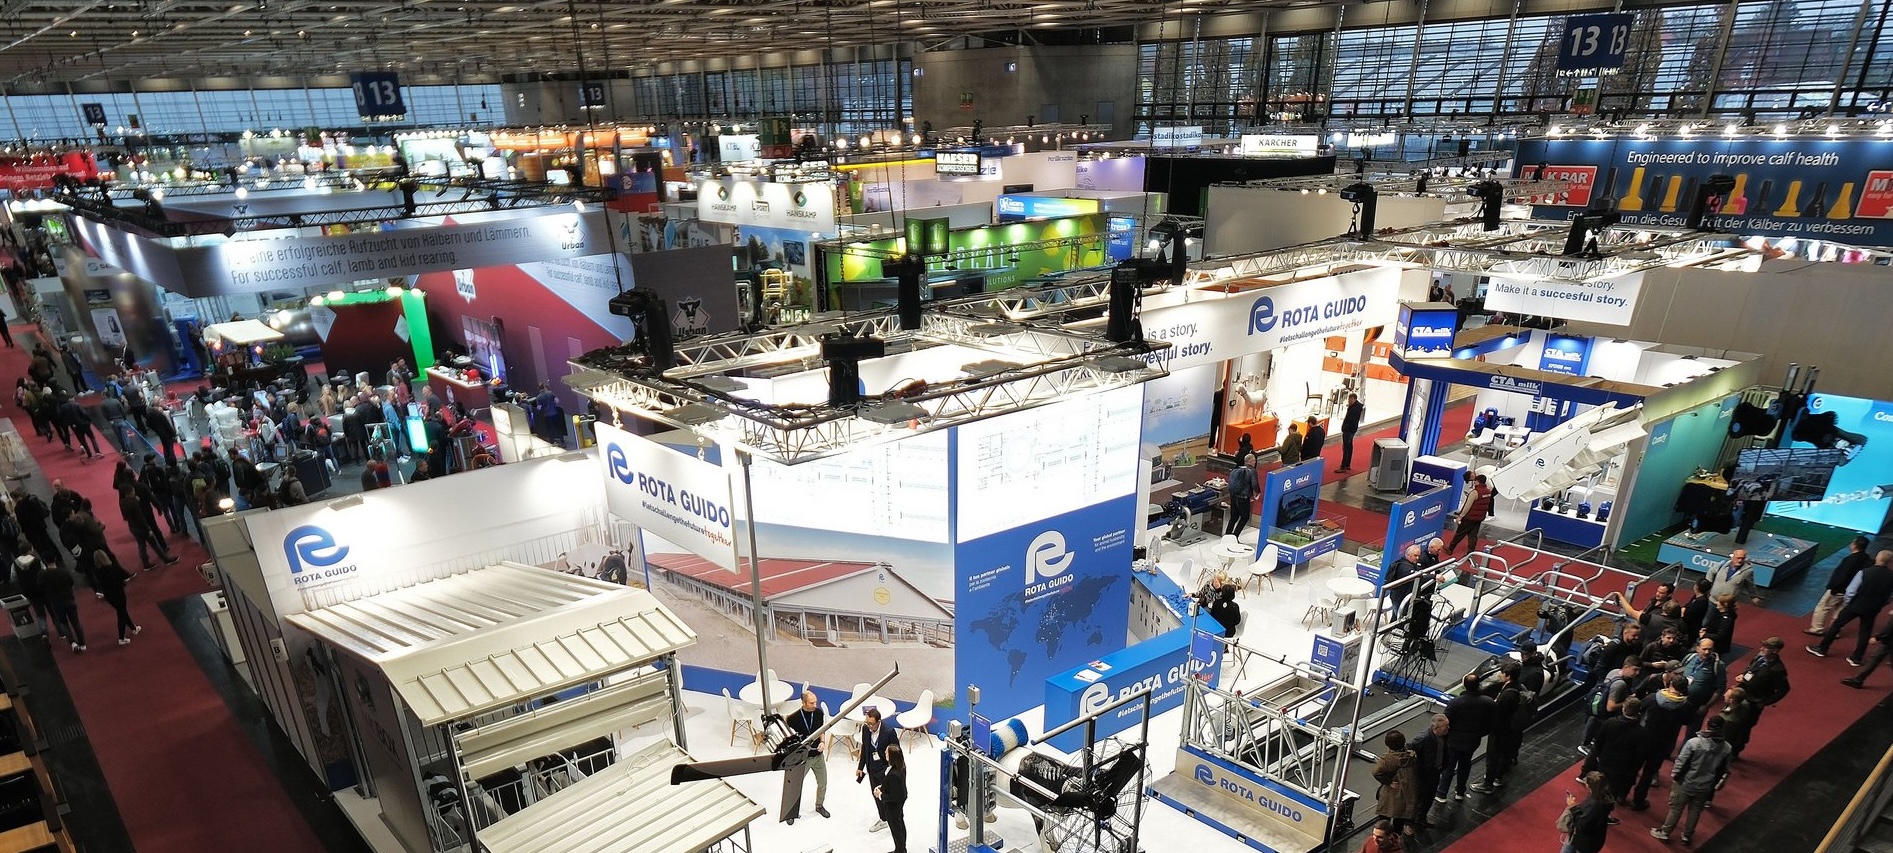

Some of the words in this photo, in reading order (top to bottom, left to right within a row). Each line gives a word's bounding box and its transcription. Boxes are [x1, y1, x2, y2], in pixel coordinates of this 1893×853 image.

[1571, 25, 1600, 57] 13
[1608, 24, 1628, 55] 13
[368, 80, 397, 106] 13
[588, 87, 603, 101] 13
[86, 106, 103, 120] 13
[936, 153, 978, 164] KAESER
[1627, 150, 1695, 166] Engineered
[1696, 152, 1710, 164] to
[1712, 152, 1766, 167] improve
[1768, 152, 1795, 165] calf
[1795, 152, 1839, 166] health
[1524, 171, 1557, 182] MLK
[1560, 172, 1588, 184] BAR
[786, 209, 817, 219] HANSKAMP
[1620, 215, 1639, 225] um
[1640, 213, 1657, 225] die
[1723, 216, 1745, 229] der
[1746, 218, 1786, 231] Kälber
[1786, 222, 1801, 232] zu
[1805, 221, 1875, 235] verbessern
[278, 243, 347, 262] erfolgreiche
[348, 236, 398, 254] Aufzucht
[400, 236, 420, 251] von
[421, 229, 462, 247] Kälbern
[464, 228, 483, 244] und
[484, 226, 532, 241] Lämmern.
[561, 241, 585, 251] Urban
[231, 269, 250, 285] For
[253, 263, 319, 283] successful
[321, 261, 346, 276] calf,
[349, 256, 376, 274] lamb
[377, 253, 397, 270] and
[400, 252, 416, 268] kid
[418, 250, 459, 267] rearing.
[986, 274, 1015, 286] LUTIONS
[1495, 283, 1521, 295] Make
[1522, 286, 1530, 295] it
[1540, 289, 1594, 303] succesful
[1596, 295, 1628, 308] story.
[1281, 304, 1319, 329] ROTA
[1323, 294, 1367, 320] GUIDO
[1147, 327, 1157, 341] is
[1160, 330, 1167, 340] a
[1169, 322, 1198, 338] story.
[1181, 341, 1213, 357] story.
[1490, 375, 1516, 388] CTA
[1517, 381, 1540, 391] milk
[637, 471, 677, 506] ROTA
[680, 489, 730, 528] GUIDO
[293, 572, 322, 585] ROTA
[324, 564, 357, 578] GUIDO
[1024, 579, 1047, 597] ROTA
[1048, 573, 1074, 588] GUIDO
[274, 646, 281, 654] B
[1119, 673, 1163, 702] ROTA
[1220, 777, 1255, 802] ROTA
[1258, 794, 1302, 822] GUIDO
